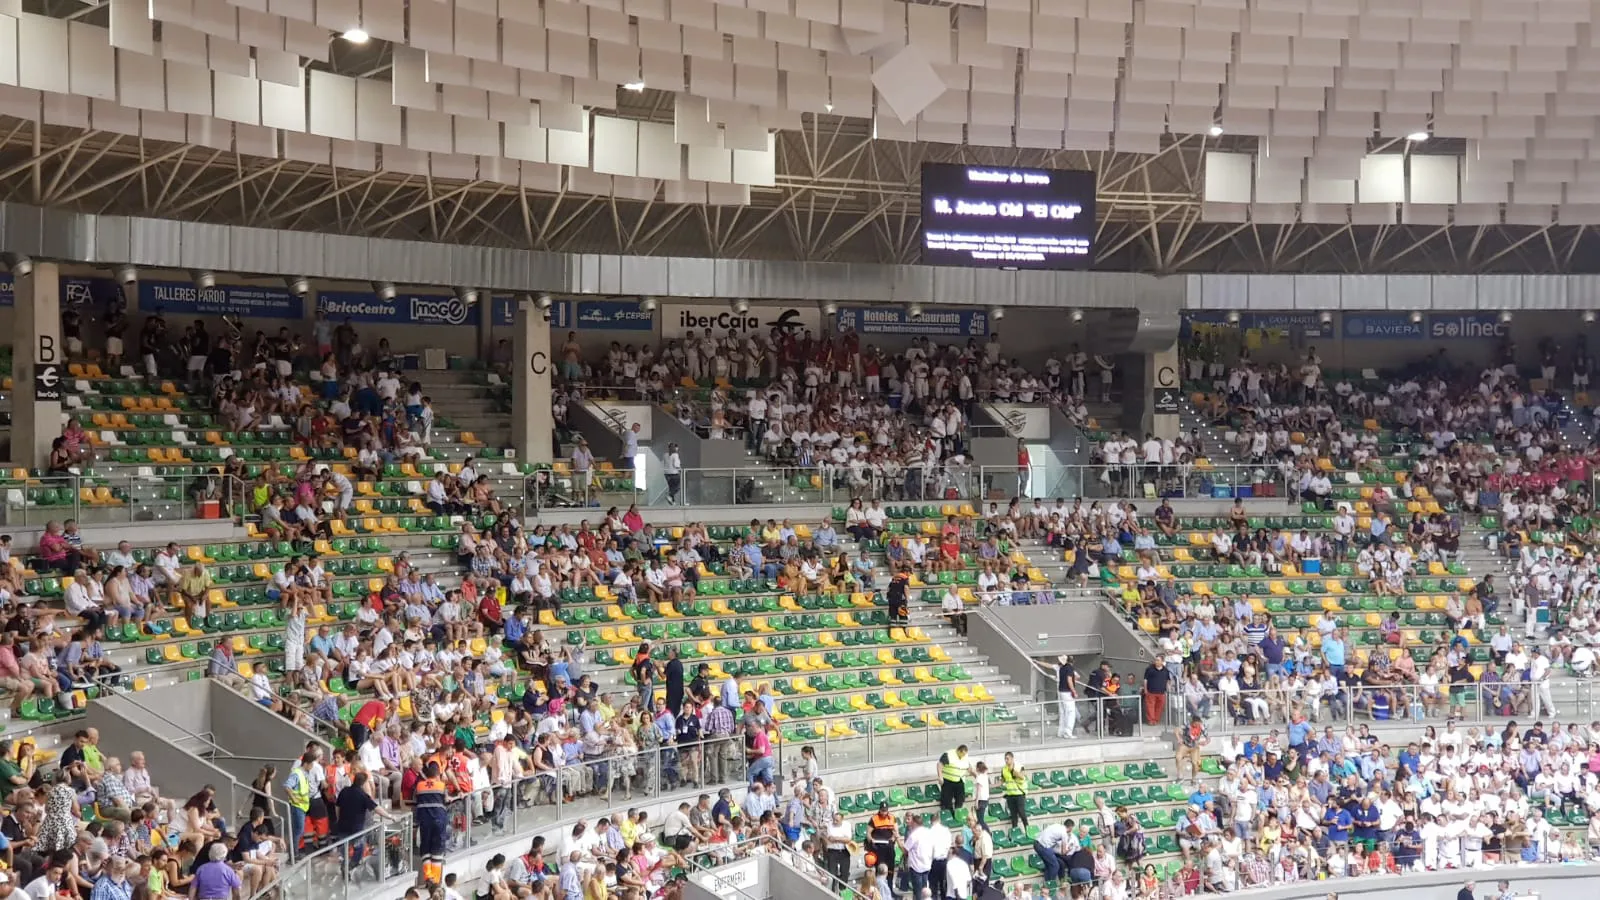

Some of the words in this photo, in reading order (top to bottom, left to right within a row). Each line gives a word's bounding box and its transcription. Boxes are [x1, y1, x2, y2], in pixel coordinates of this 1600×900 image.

[153, 286, 197, 302] TALLERES
[198, 288, 226, 304] PARDO
[327, 301, 396, 315] BricoCentro
[863, 310, 899, 323] Hoteles
[680, 310, 759, 333] iberCaja
[1366, 325, 1421, 335] BAVIERA
[1432, 316, 1505, 337] solinec
[40, 335, 54, 362] B
[531, 352, 547, 375] C
[1158, 366, 1174, 386] C
